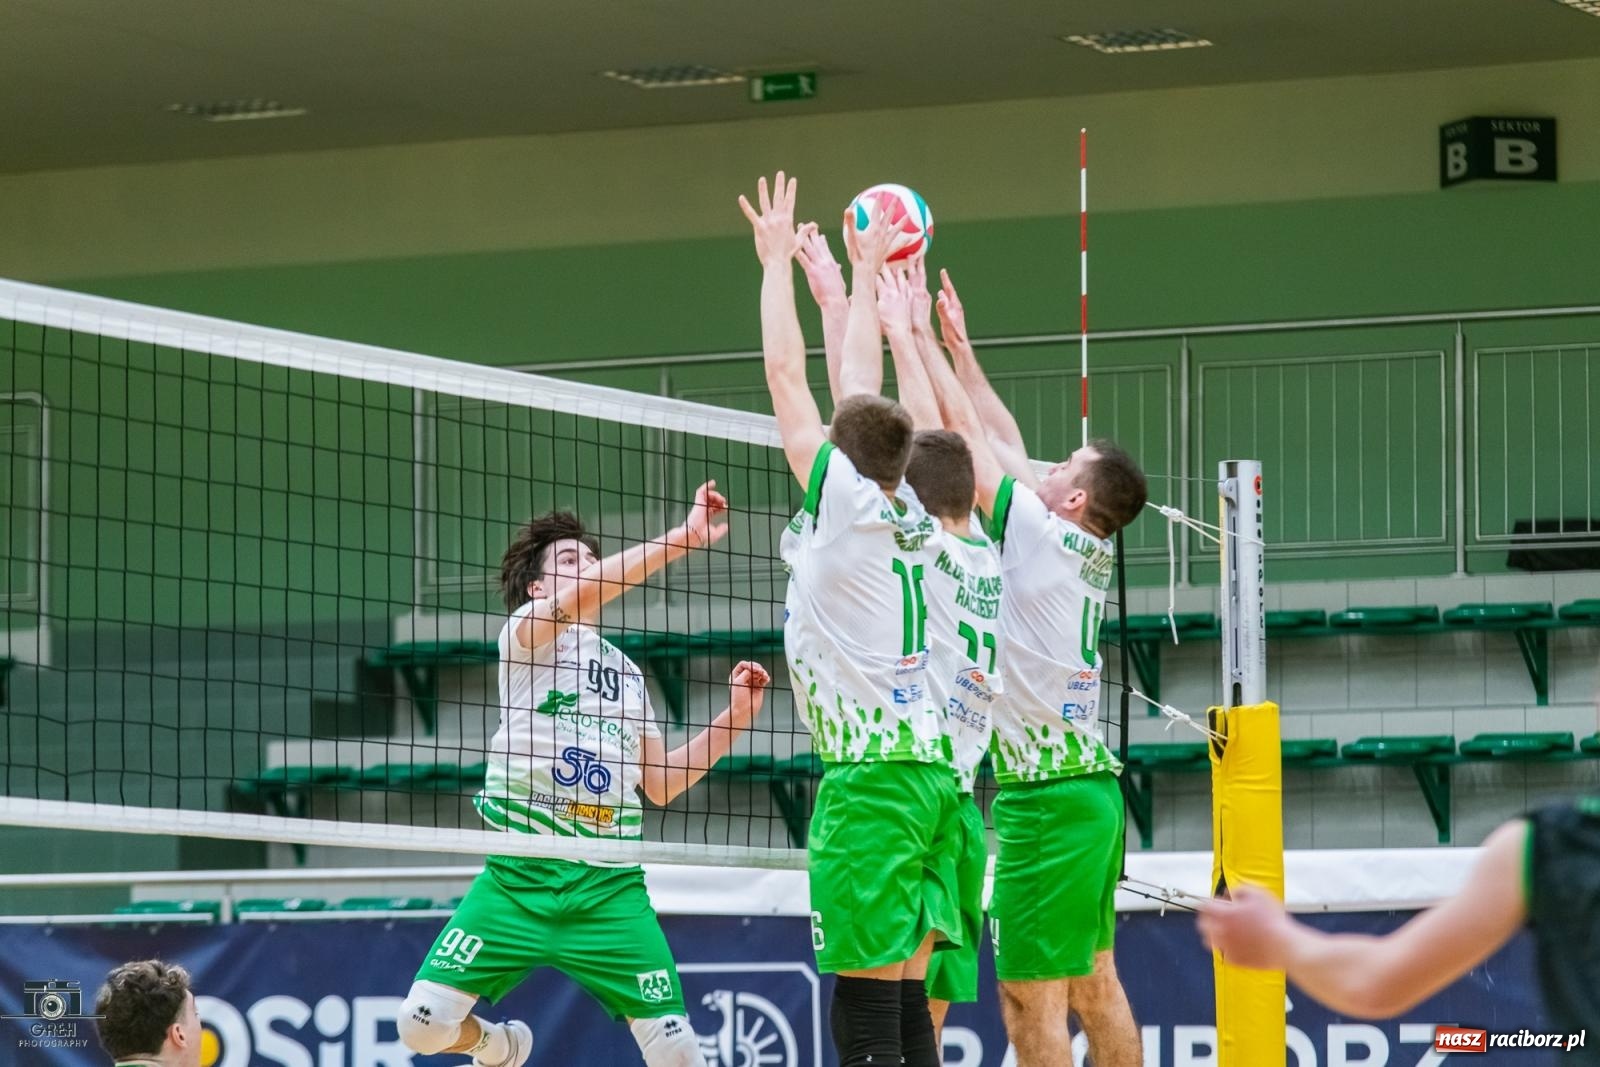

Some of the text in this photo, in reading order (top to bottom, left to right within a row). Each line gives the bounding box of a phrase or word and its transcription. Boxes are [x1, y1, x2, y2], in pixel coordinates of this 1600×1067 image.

[1490, 120, 1542, 133] SEKTOR
[1447, 142, 1468, 179] B
[1493, 137, 1539, 174] B
[586, 658, 619, 701] 99
[435, 928, 484, 964] 99
